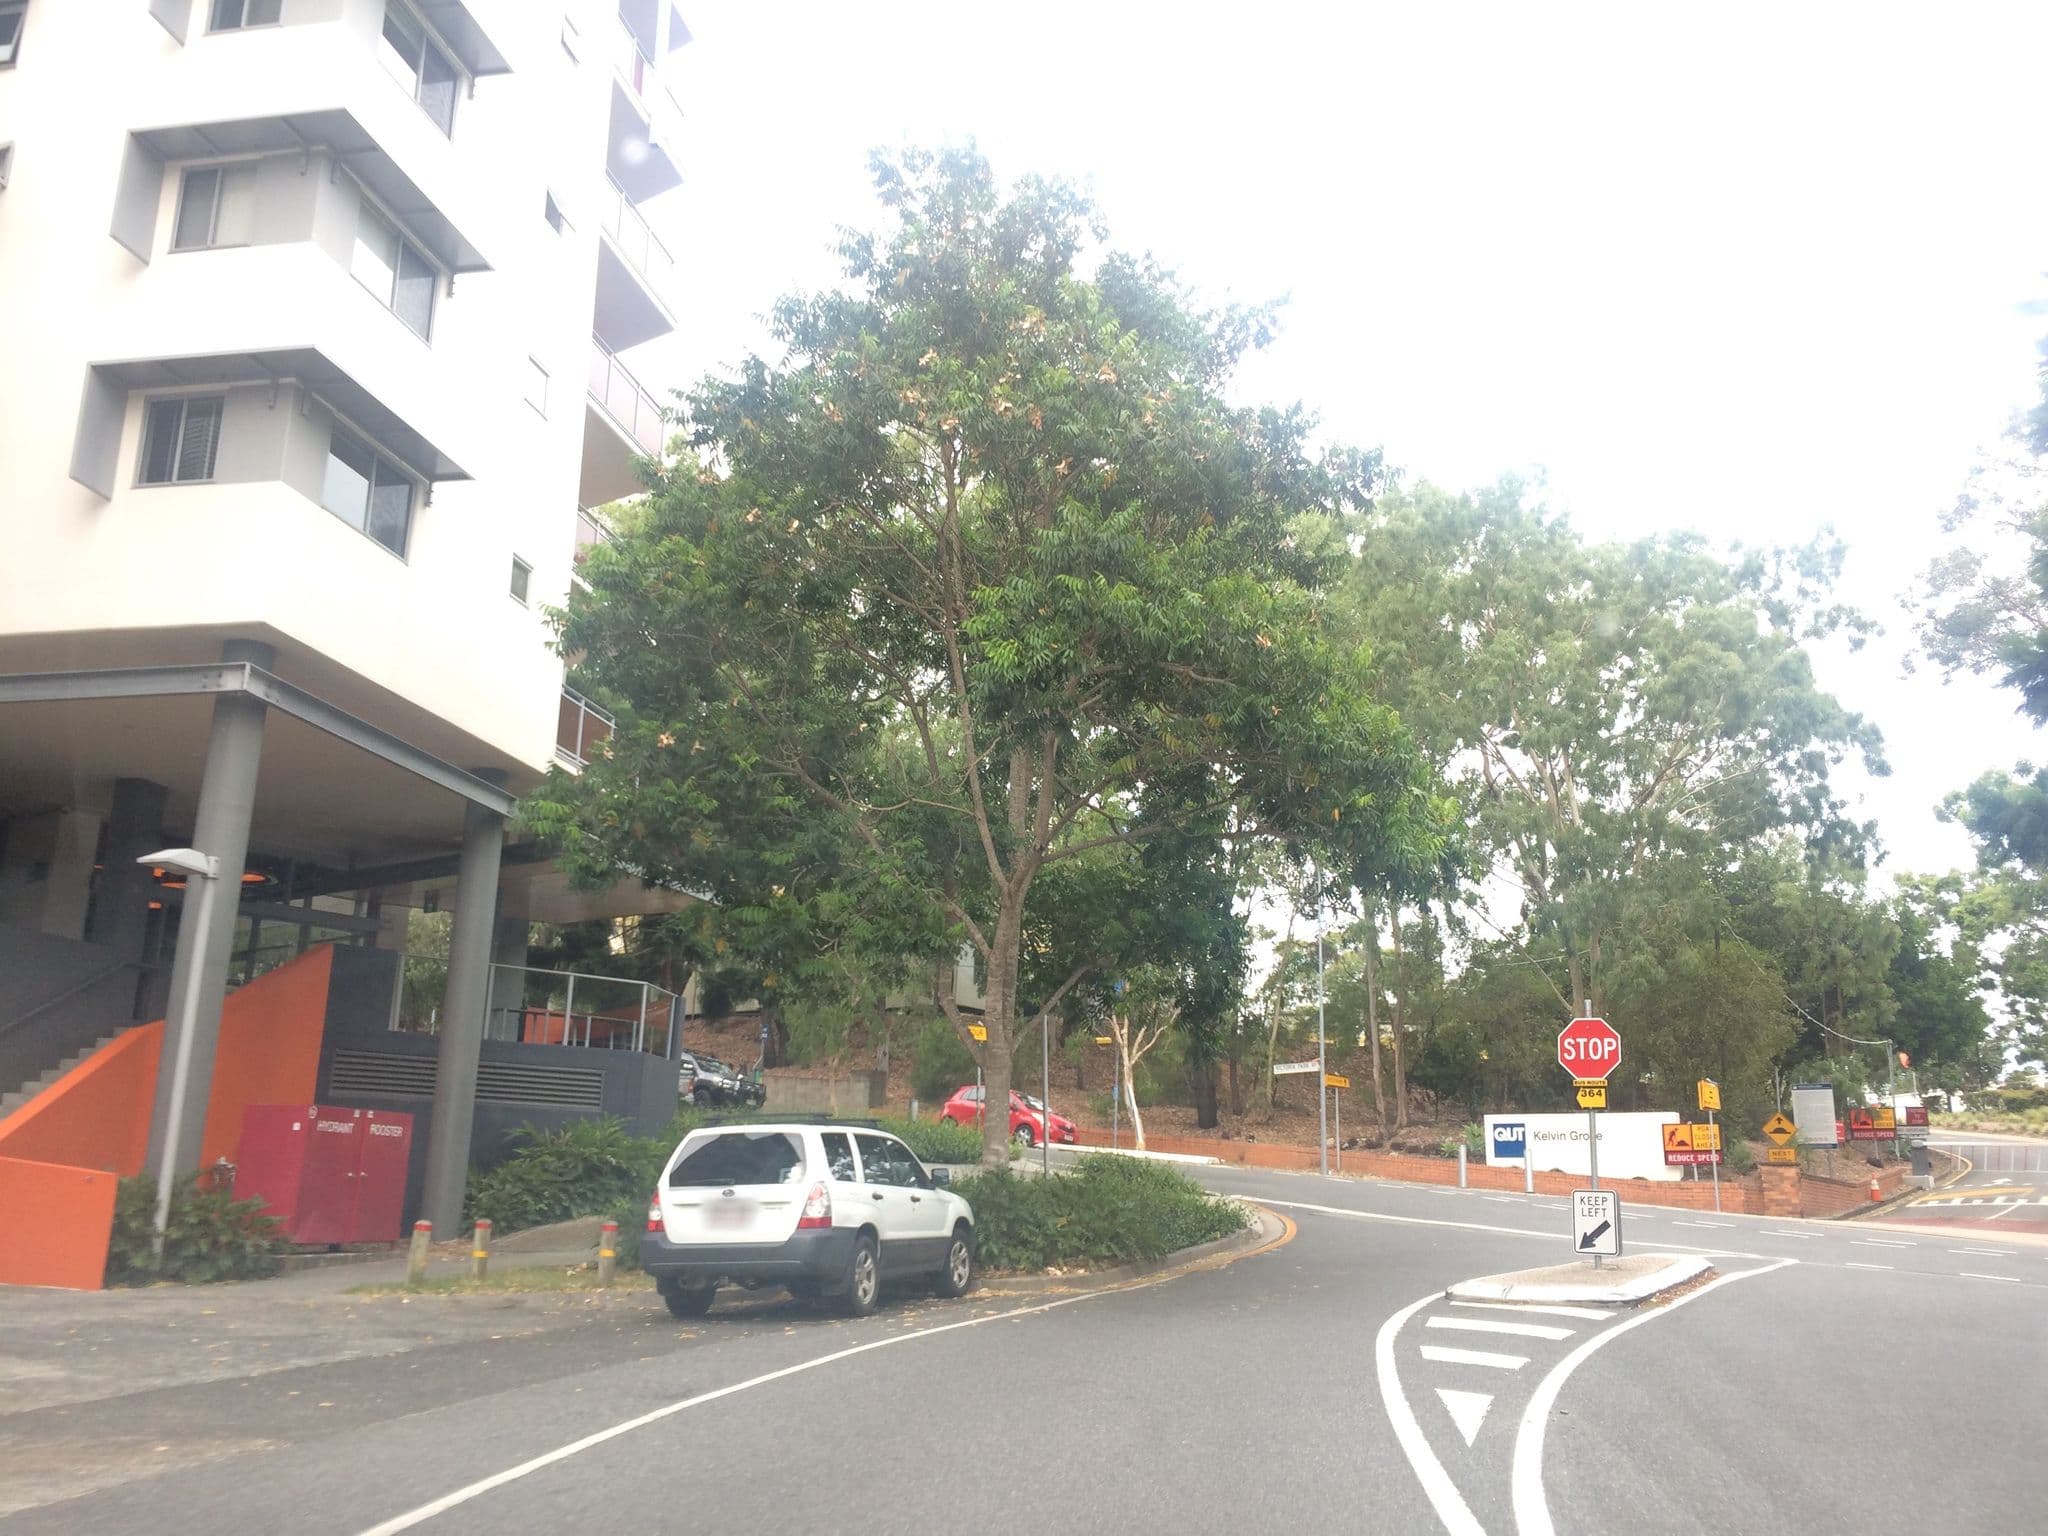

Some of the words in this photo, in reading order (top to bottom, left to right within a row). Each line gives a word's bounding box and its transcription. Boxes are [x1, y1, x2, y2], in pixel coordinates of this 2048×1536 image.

[1564, 1037, 1617, 1060] STOP
[1580, 1089, 1602, 1097] 364
[317, 1120, 355, 1134] HYDRANT
[1494, 1127, 1525, 1142] QUT
[1533, 1131, 1567, 1141] Kelvin
[1569, 1131, 1603, 1141] Groe
[1668, 1154, 1694, 1162] REDUCE
[1580, 1196, 1608, 1206] KEEP
[1581, 1207, 1607, 1217] LEFT
